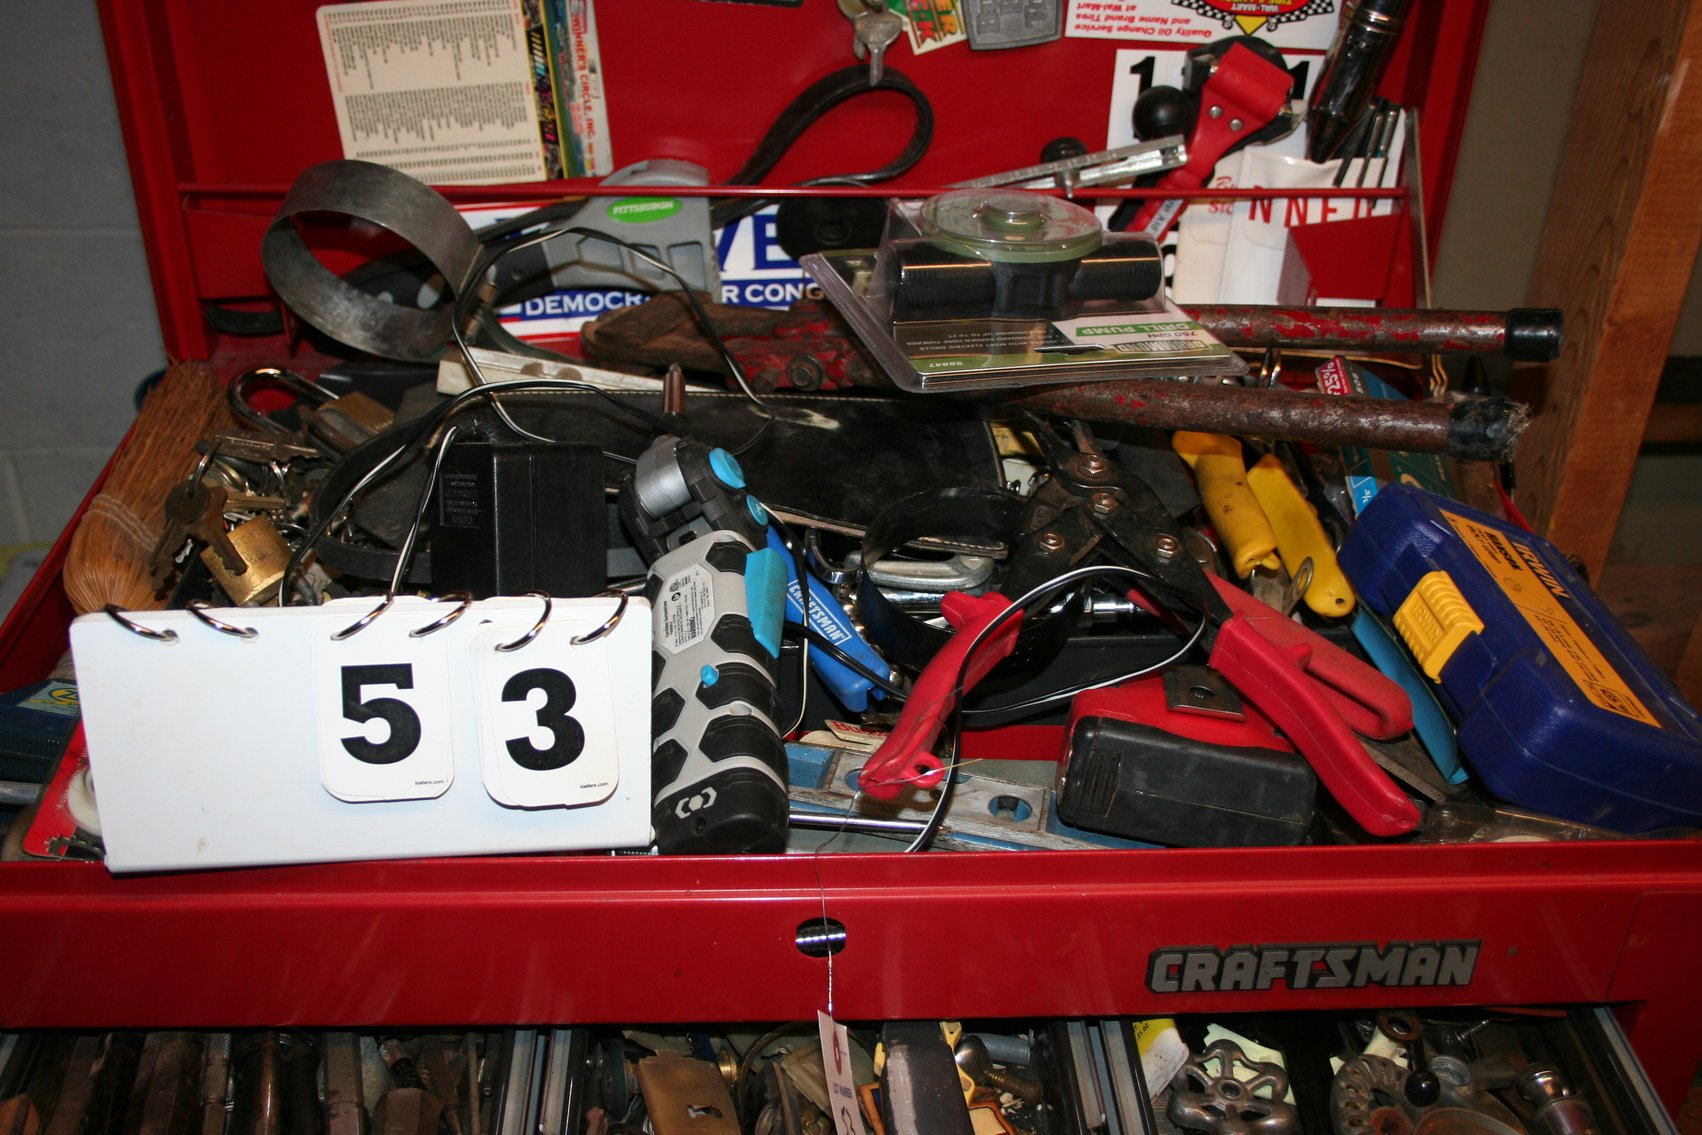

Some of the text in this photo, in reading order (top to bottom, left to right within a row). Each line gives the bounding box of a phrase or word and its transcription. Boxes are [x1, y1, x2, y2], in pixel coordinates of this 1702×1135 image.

[1077, 2, 1125, 12] Wal-Mart
[1230, 3, 1280, 12] WAL-MART
[1076, 13, 1100, 21] Tires
[1105, 14, 1134, 23] Brand
[1142, 16, 1170, 24] Name
[1074, 23, 1212, 38] Quality Oil Change Service
[570, 14, 590, 72] WINNER'S
[612, 200, 674, 216] PITTSBURGH
[525, 291, 651, 316] DEMOCR
[1081, 323, 1189, 336] DRILL PUMP
[1115, 340, 1205, 352] DRUMMOND
[1511, 540, 1572, 600] IRWIN
[340, 662, 586, 771] 5 3
[1149, 941, 1479, 993] CRAFTSMAN
